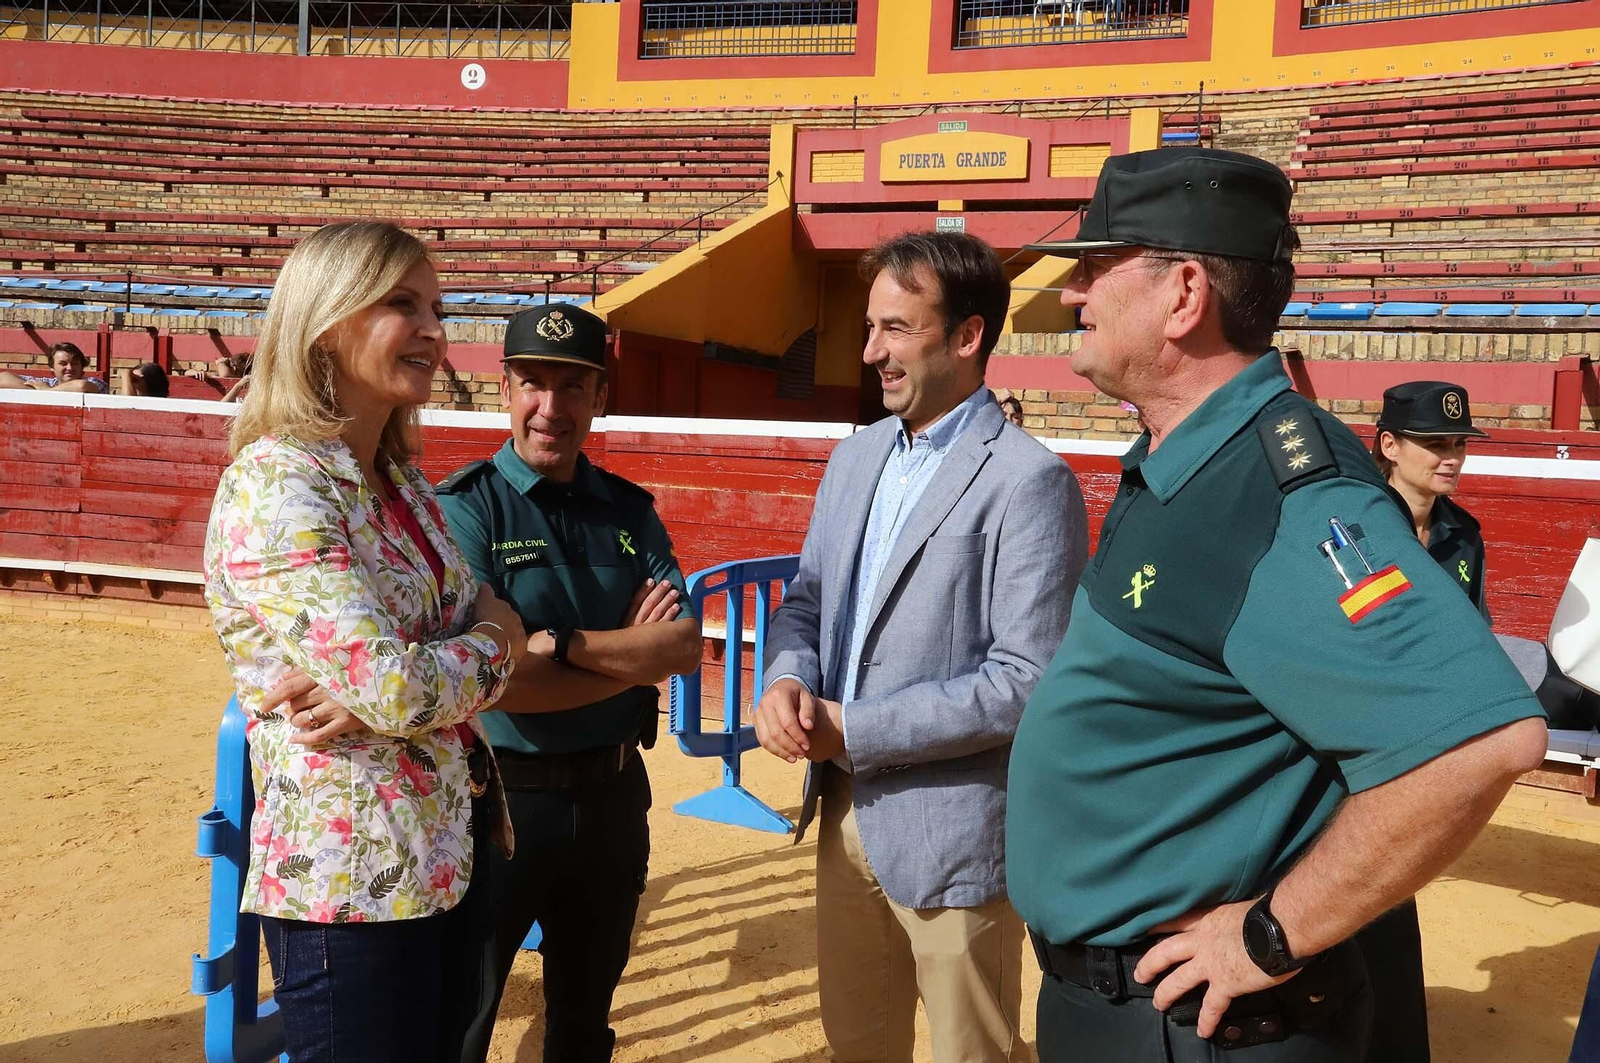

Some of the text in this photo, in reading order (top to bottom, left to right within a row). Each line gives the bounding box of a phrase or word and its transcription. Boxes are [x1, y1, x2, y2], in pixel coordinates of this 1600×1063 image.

[468, 69, 478, 84] 2
[899, 152, 1006, 169] PUERTA GRANDE
[1575, 203, 1588, 212] 17
[938, 219, 954, 228] SALIDA
[1382, 264, 1395, 273] 14
[1445, 264, 1457, 272] 13
[1508, 263, 1521, 272] 12
[1573, 263, 1583, 272] 11
[1371, 291, 1387, 300] 14
[1434, 291, 1448, 300] 13
[1500, 290, 1515, 300] 12
[1562, 290, 1576, 301] 11
[1557, 446, 1569, 460] 3
